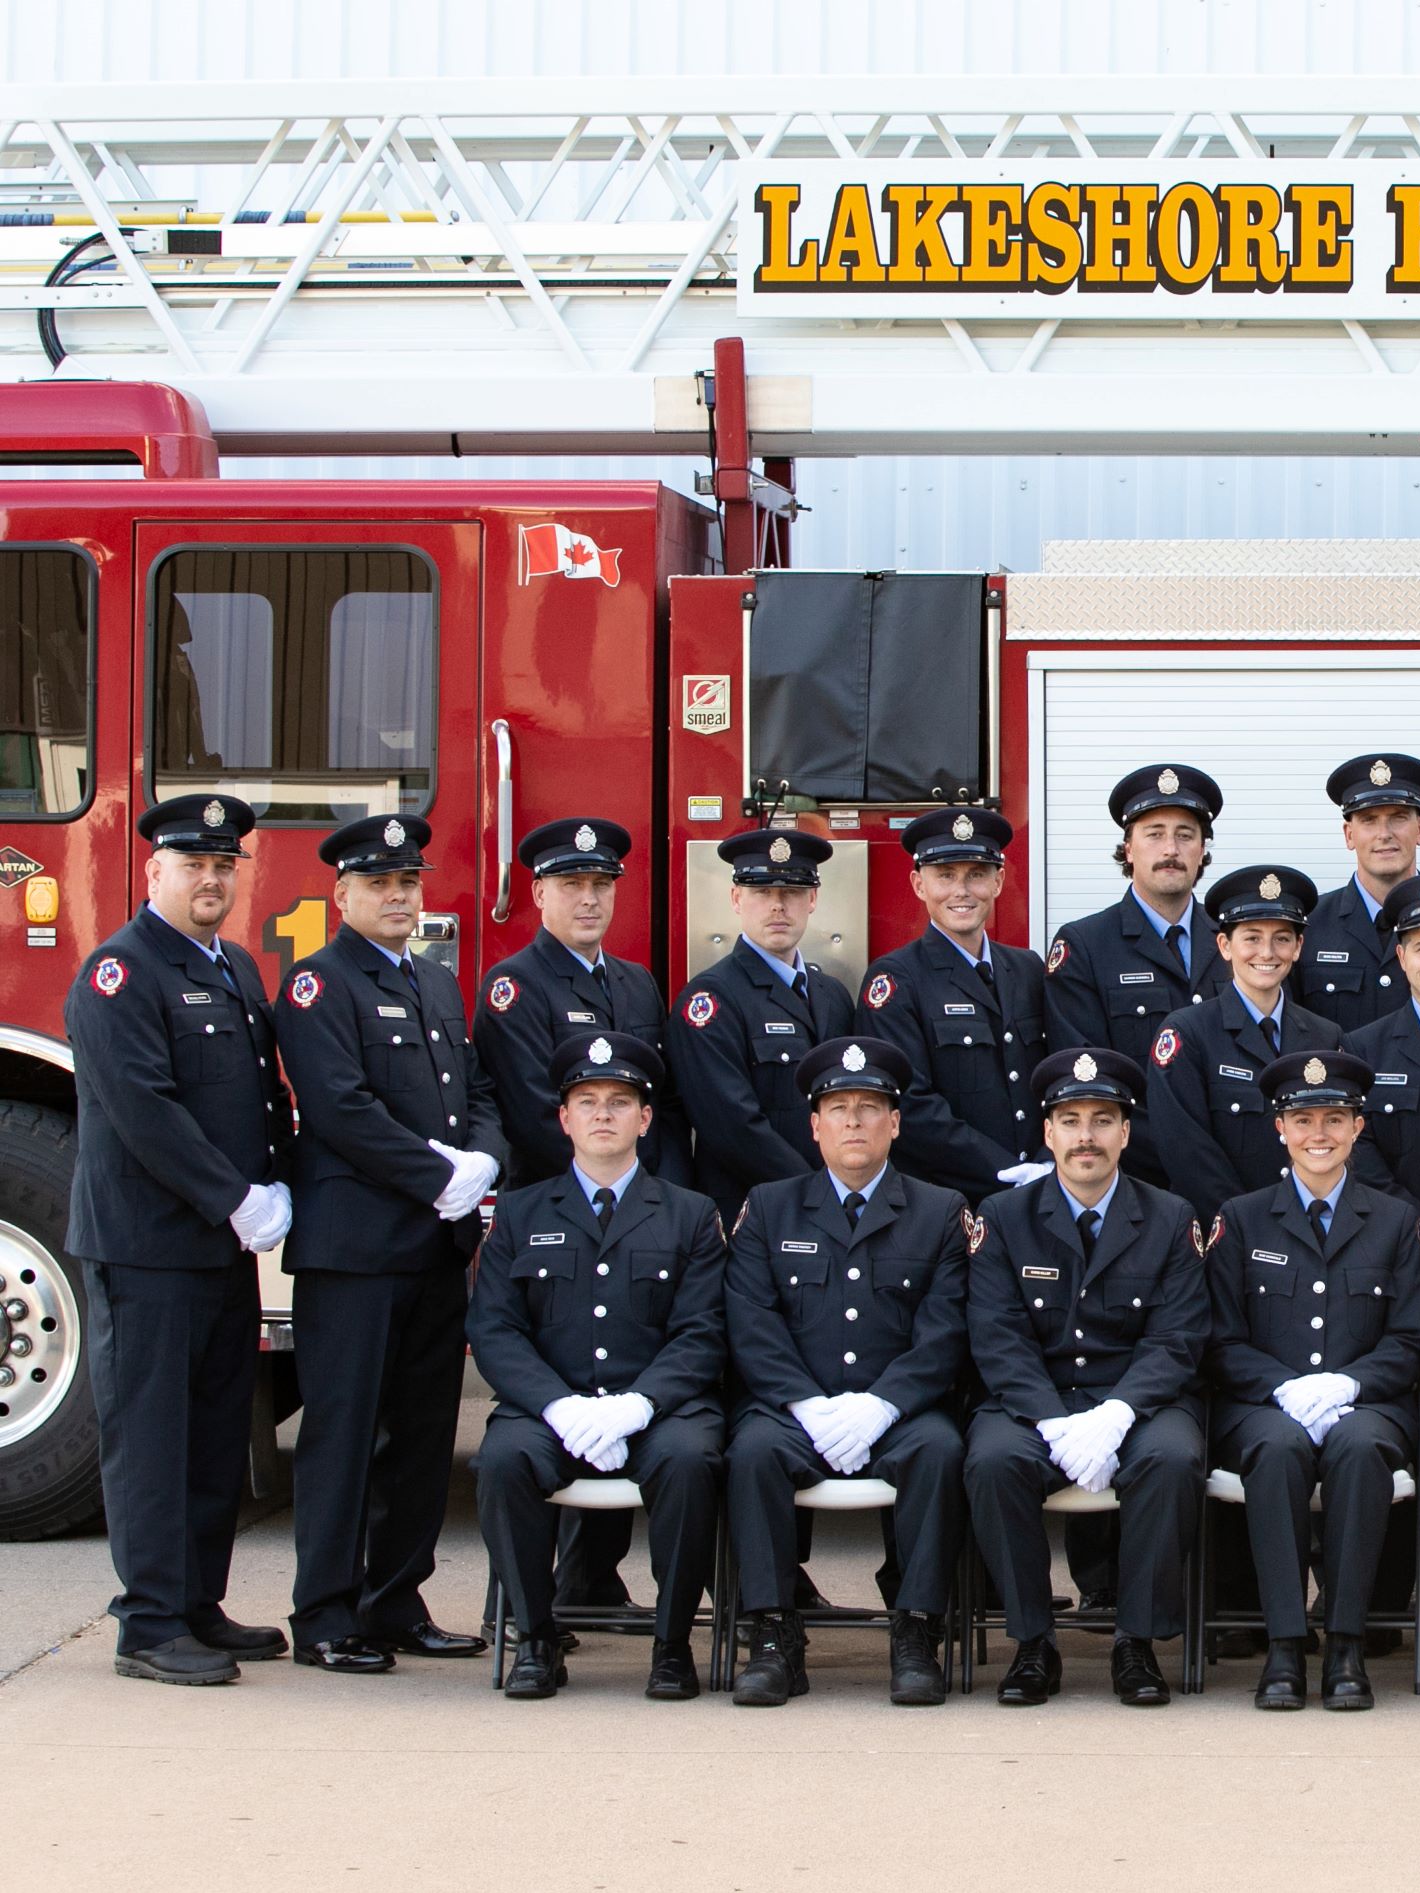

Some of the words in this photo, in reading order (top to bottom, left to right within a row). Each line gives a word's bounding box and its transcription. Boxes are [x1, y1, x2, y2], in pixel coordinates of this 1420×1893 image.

[754, 182, 1354, 296] LAKESHORE
[687, 712, 726, 725] smeal
[263, 896, 328, 964] 1
